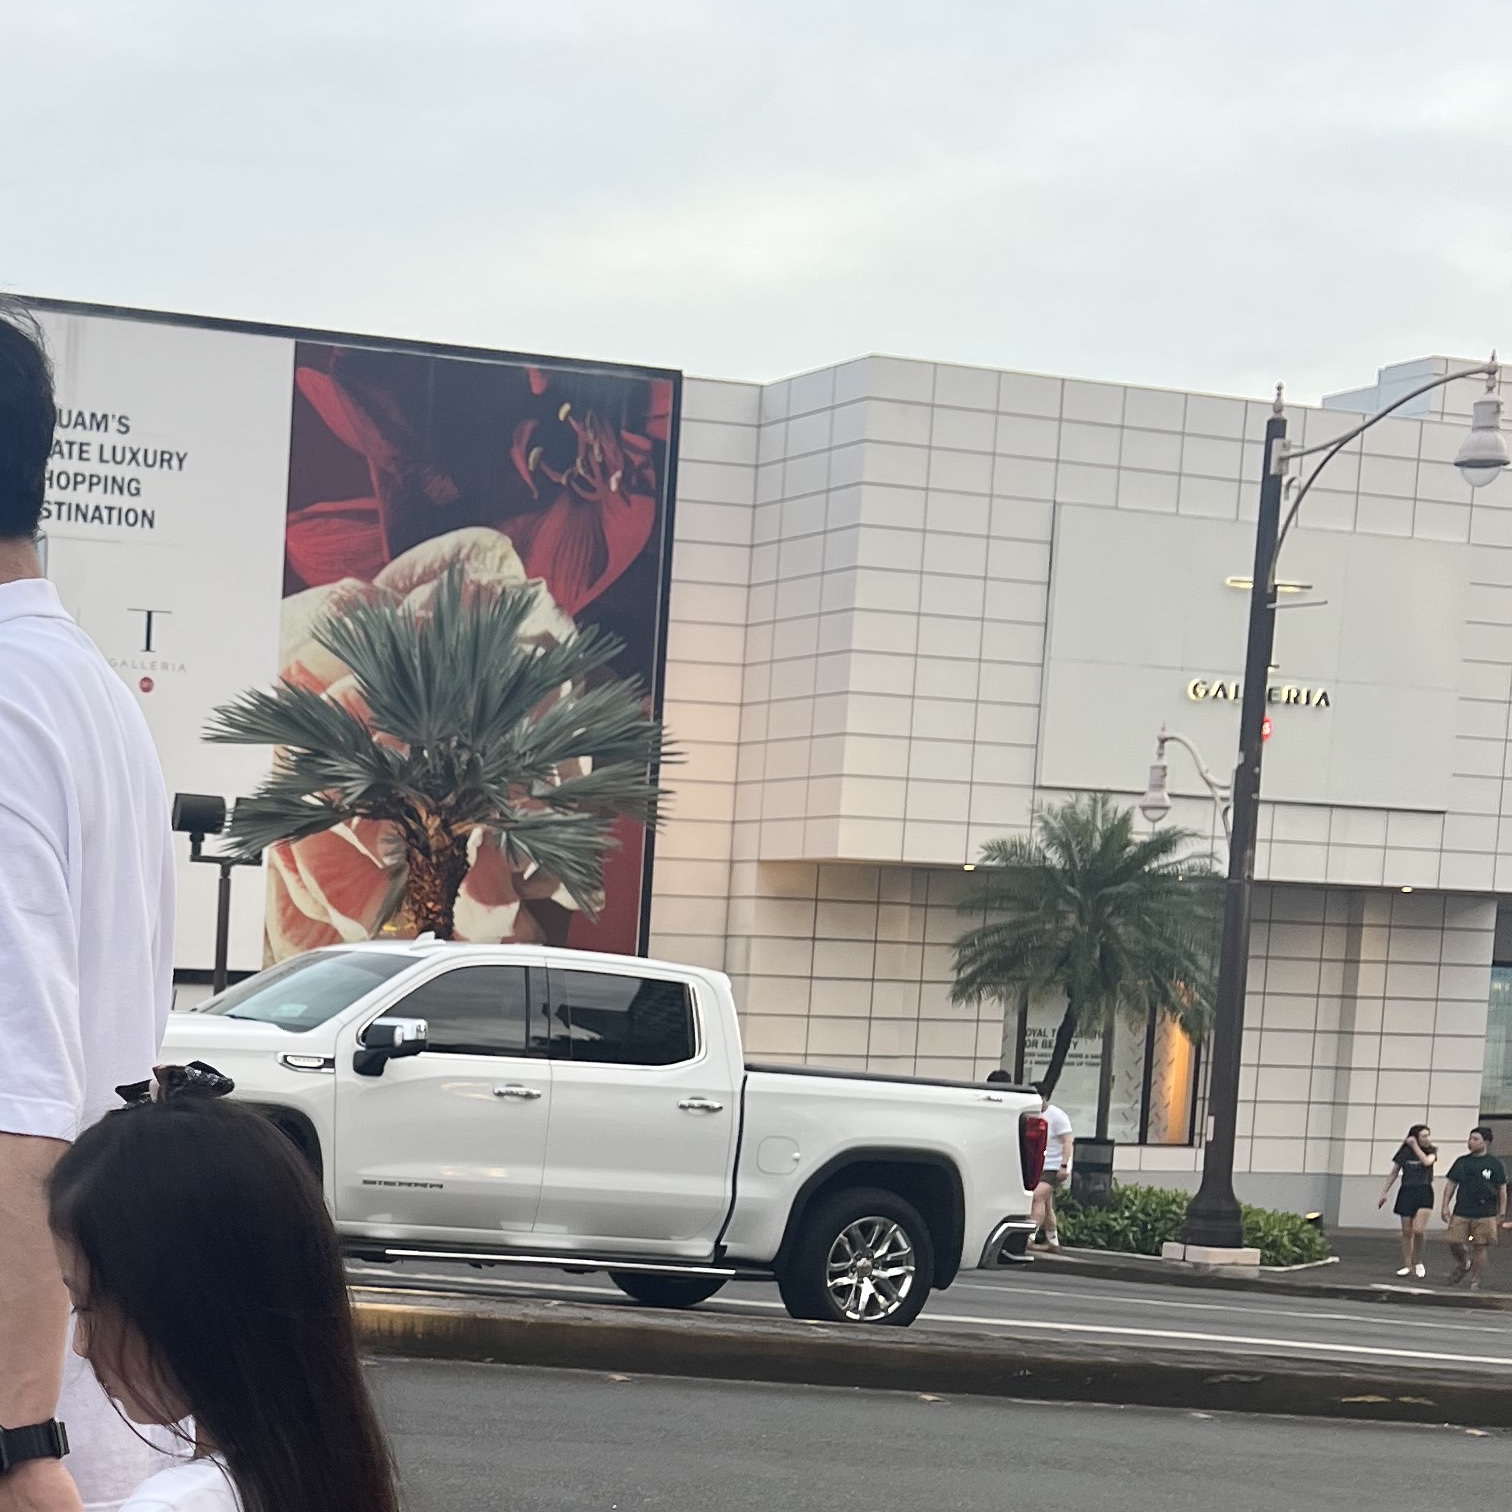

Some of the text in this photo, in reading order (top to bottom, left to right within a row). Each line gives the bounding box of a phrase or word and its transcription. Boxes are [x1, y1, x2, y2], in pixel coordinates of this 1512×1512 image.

[99, 443, 188, 471] LUXURY
[127, 607, 173, 652] T
[109, 658, 187, 673] GALLERIA
[1190, 679, 1330, 707] GALERIA
